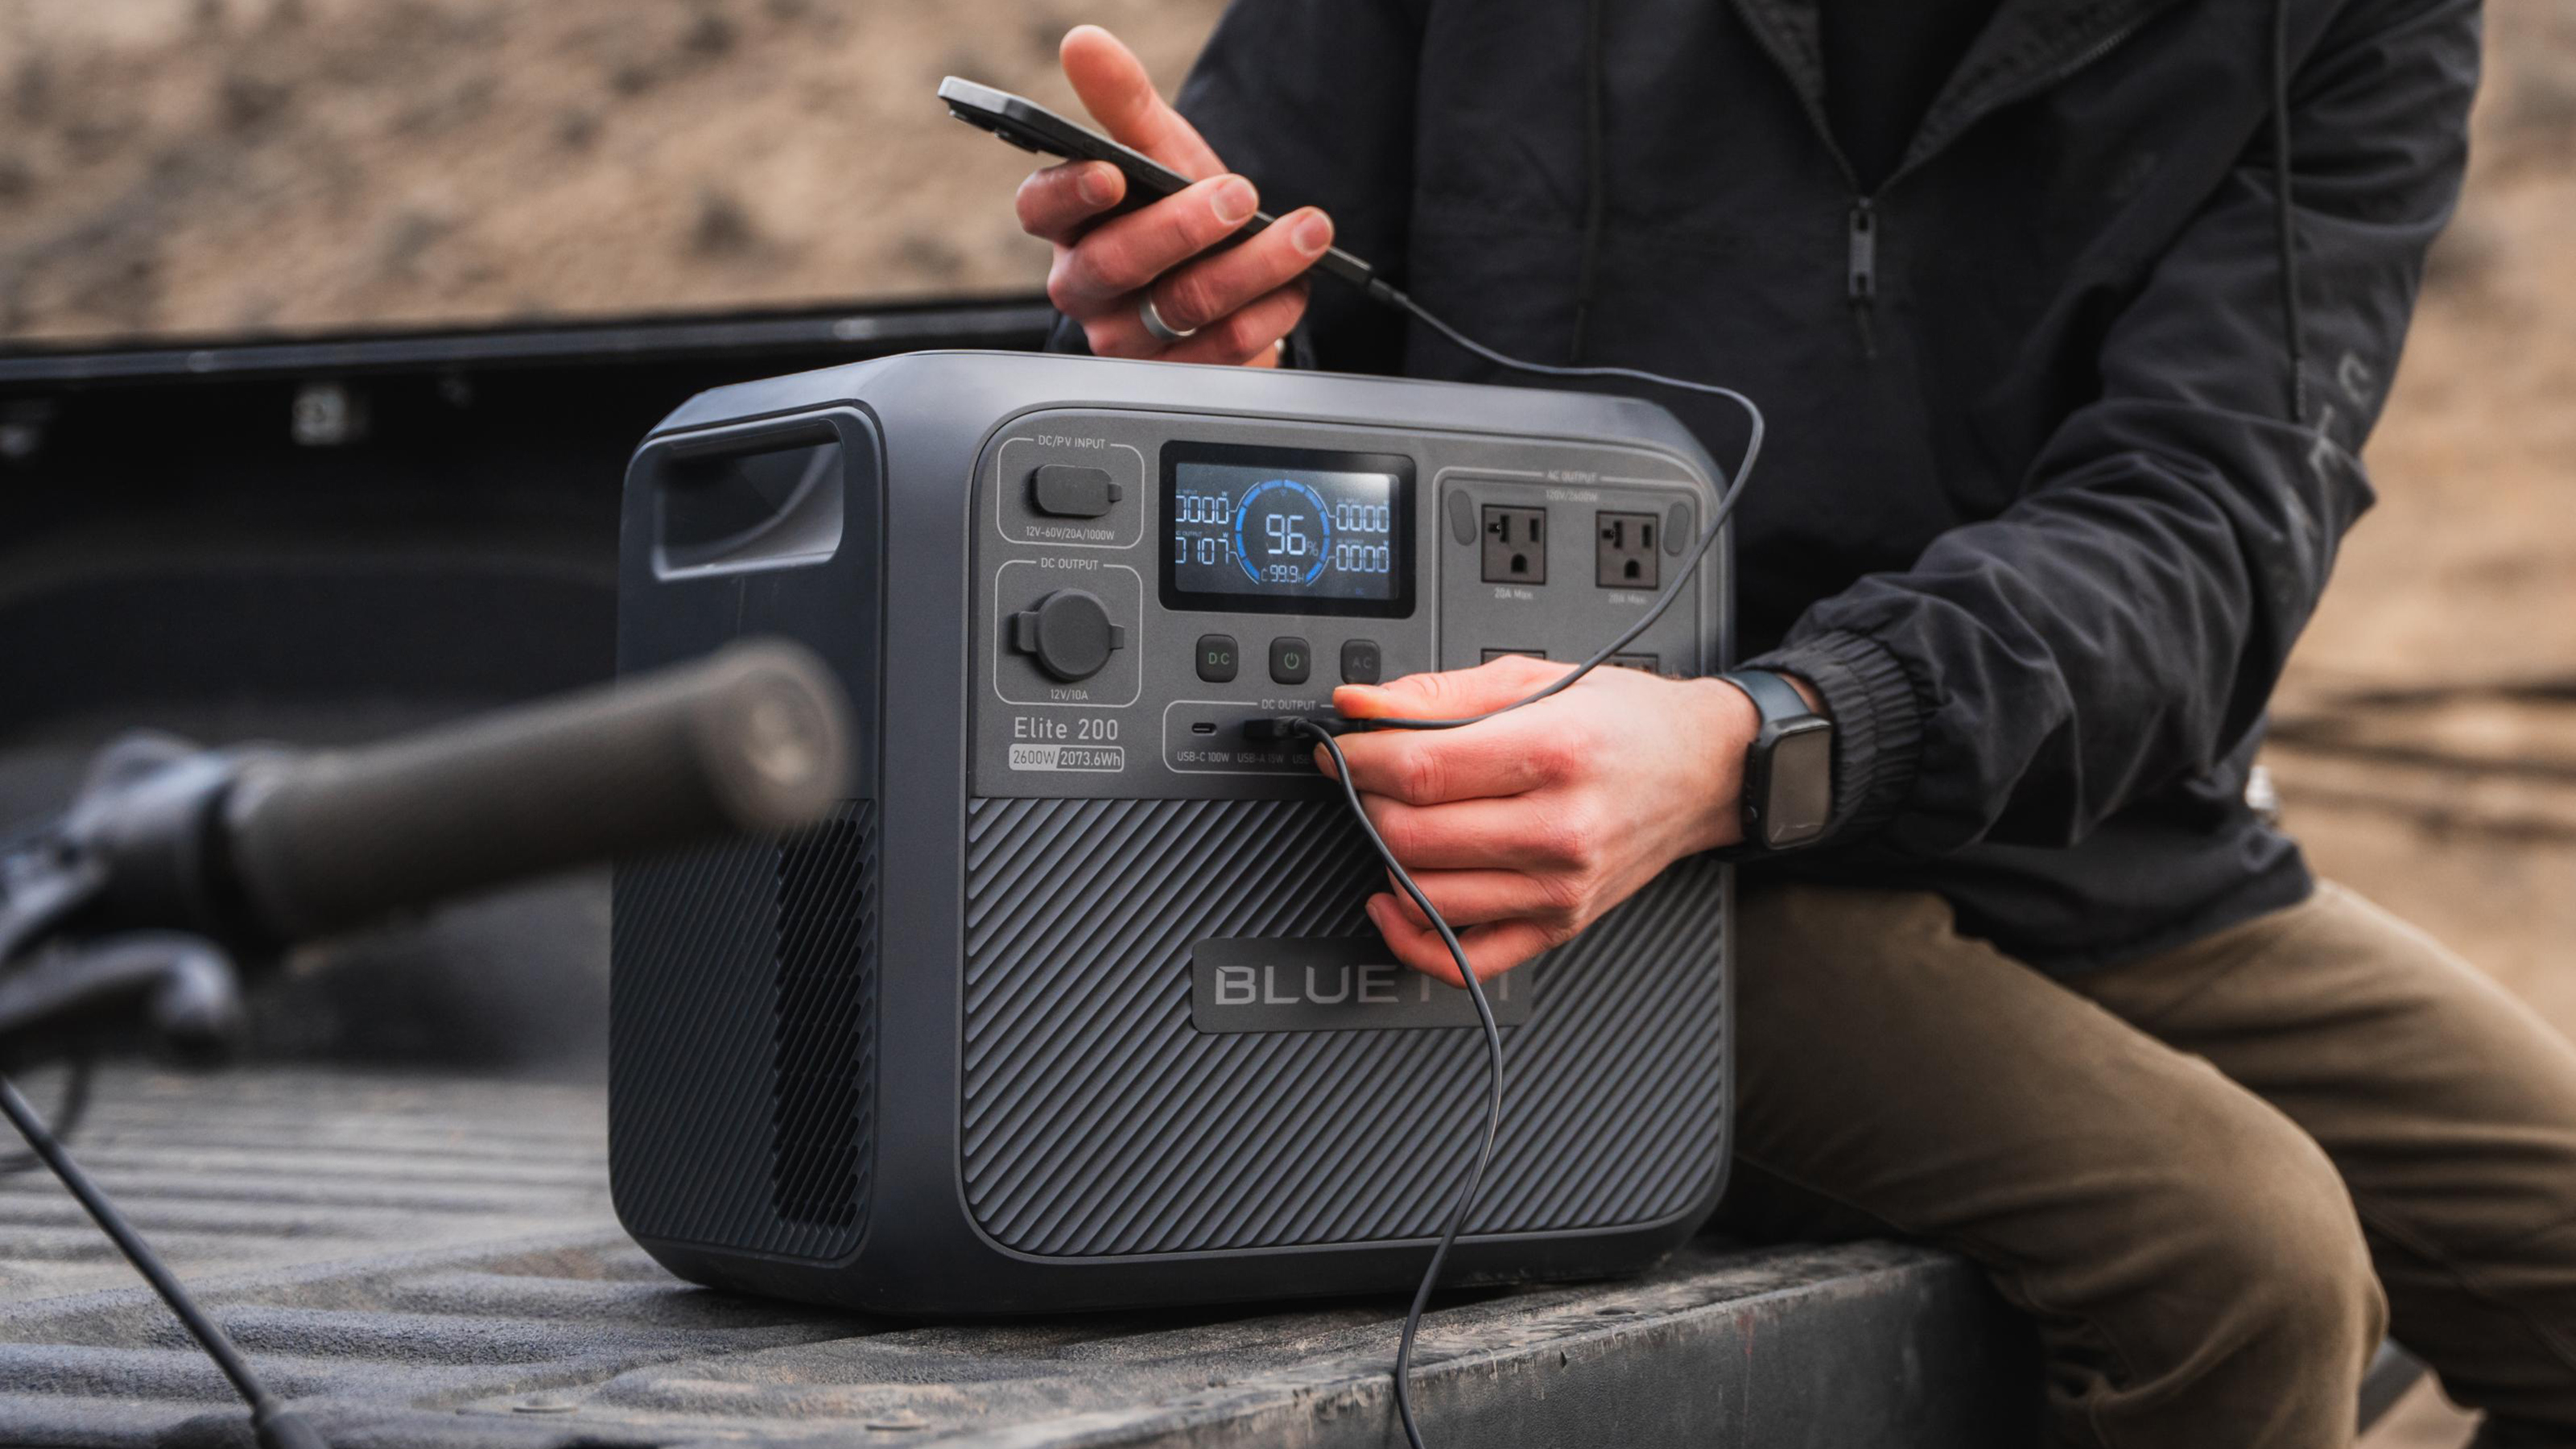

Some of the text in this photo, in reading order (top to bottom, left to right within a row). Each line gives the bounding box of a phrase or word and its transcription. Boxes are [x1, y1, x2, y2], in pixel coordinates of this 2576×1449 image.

[1038, 435, 1106, 449] DC/PV INPUT
[1547, 470, 1597, 484] AC OUTPUT
[1336, 504, 1389, 533] 0000
[1041, 558, 1099, 570] DC OUTPUT
[1336, 544, 1389, 573] 0000
[1208, 653, 1230, 666] DC
[1352, 656, 1373, 669] AC
[1051, 688, 1088, 701] 12V/10A
[1261, 699, 1316, 711] DC OUTPUT
[1014, 716, 1118, 741] Elite 200
[1013, 749, 1121, 767] 2600W 2073.6Wh
[1177, 751, 1230, 762] USB-C 100W
[1236, 753, 1265, 763] USB-A
[1216, 965, 1509, 1005] BLUEI
